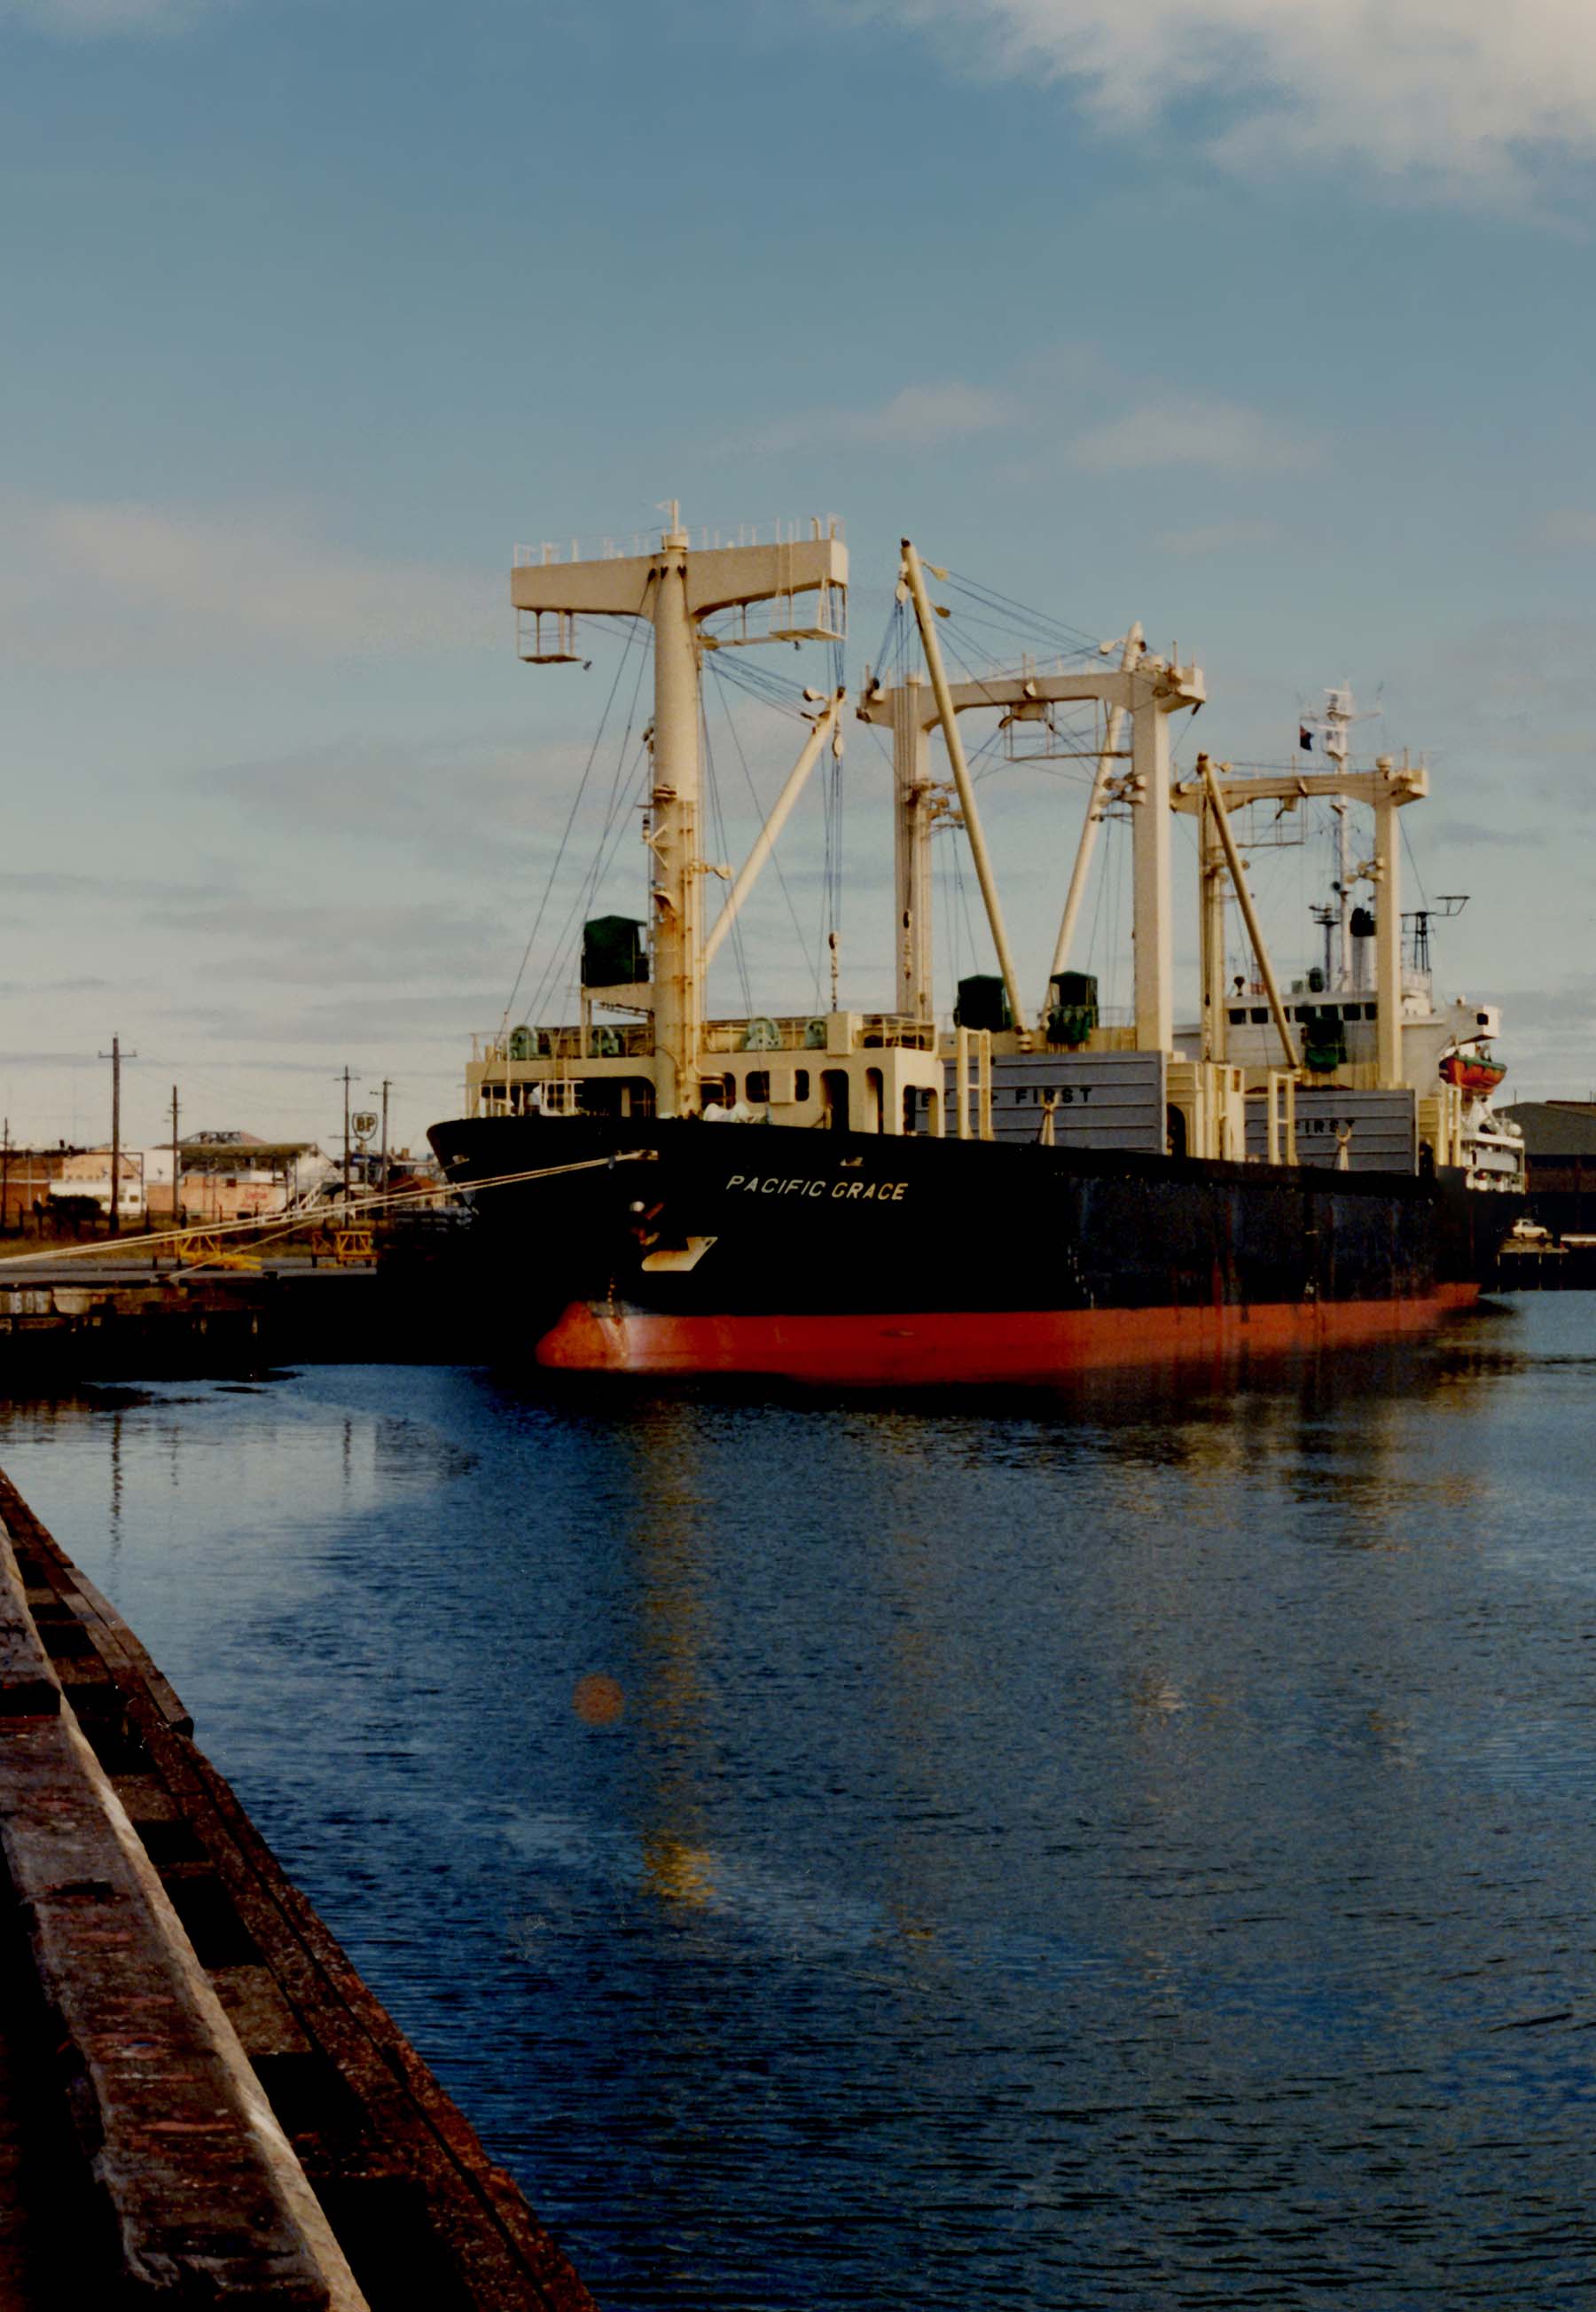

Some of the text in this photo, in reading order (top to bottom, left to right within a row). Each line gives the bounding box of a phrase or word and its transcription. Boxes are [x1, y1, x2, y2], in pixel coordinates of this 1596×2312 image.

[1015, 1087, 1091, 1105] FIRST
[356, 1117, 375, 1132] BP
[726, 1175, 909, 1200] PACIFIC GRACE
